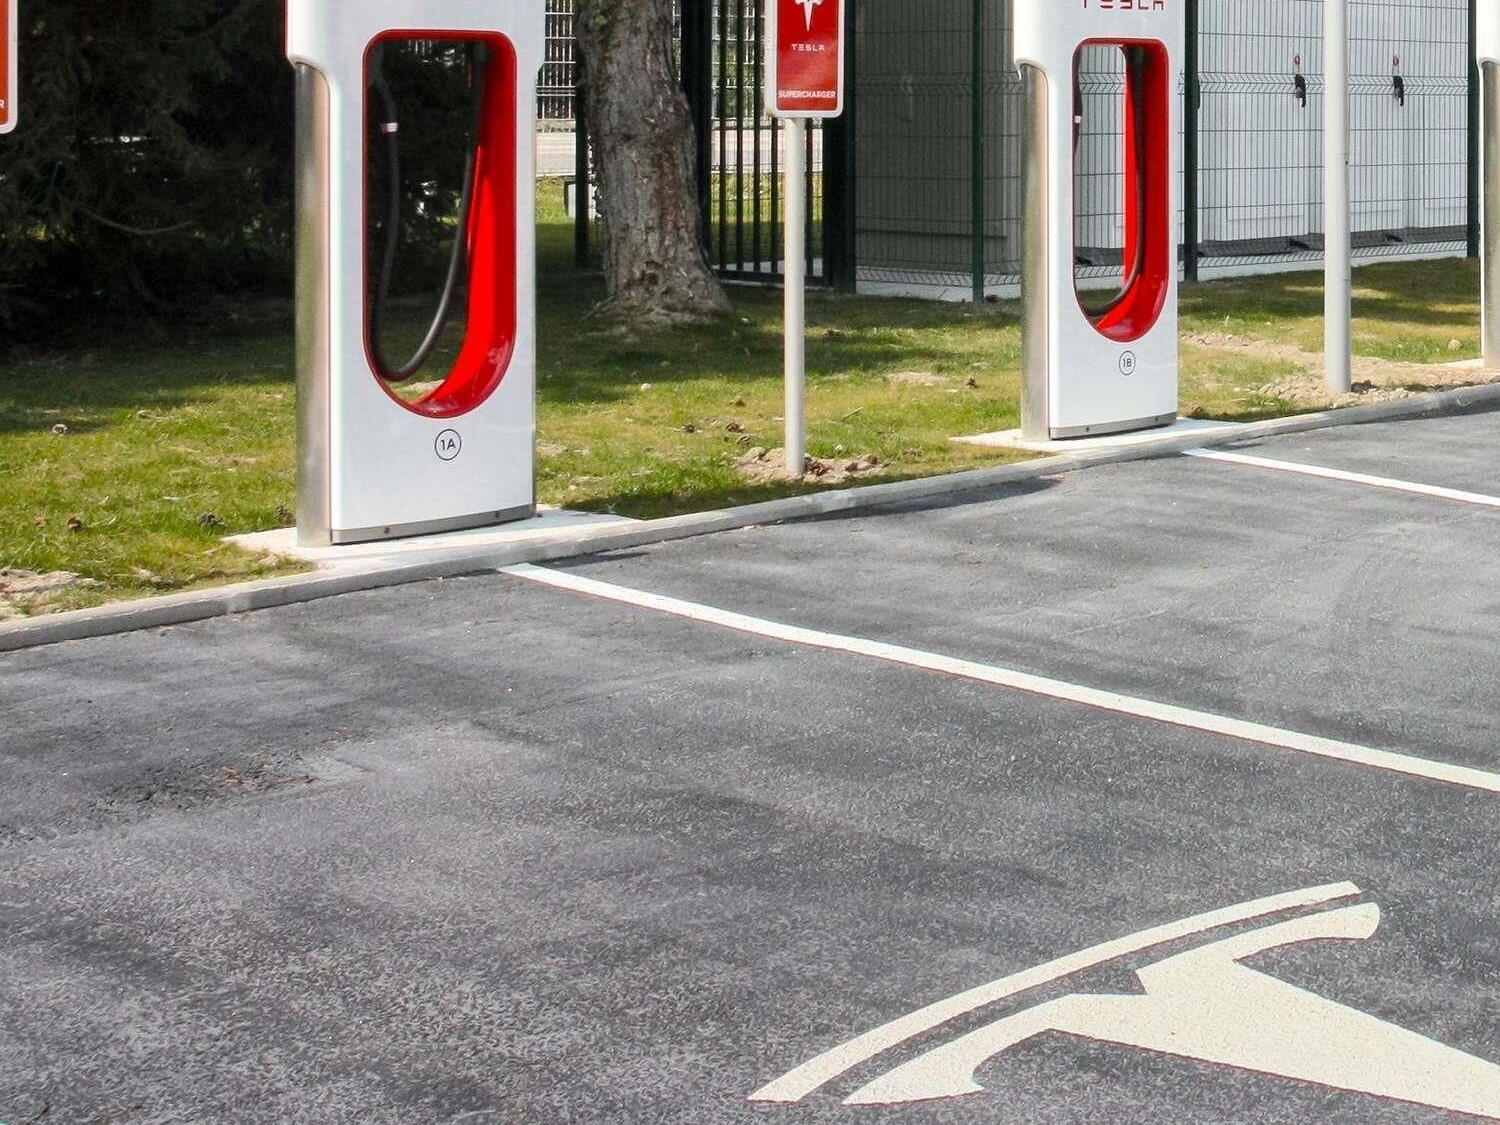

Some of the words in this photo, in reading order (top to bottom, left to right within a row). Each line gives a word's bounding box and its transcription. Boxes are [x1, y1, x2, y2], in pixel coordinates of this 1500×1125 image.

[791, 43, 826, 52] TESLA
[778, 90, 837, 99] SUPERCHARGER
[1122, 358, 1132, 367] 1B
[440, 438, 456, 451] 1A
